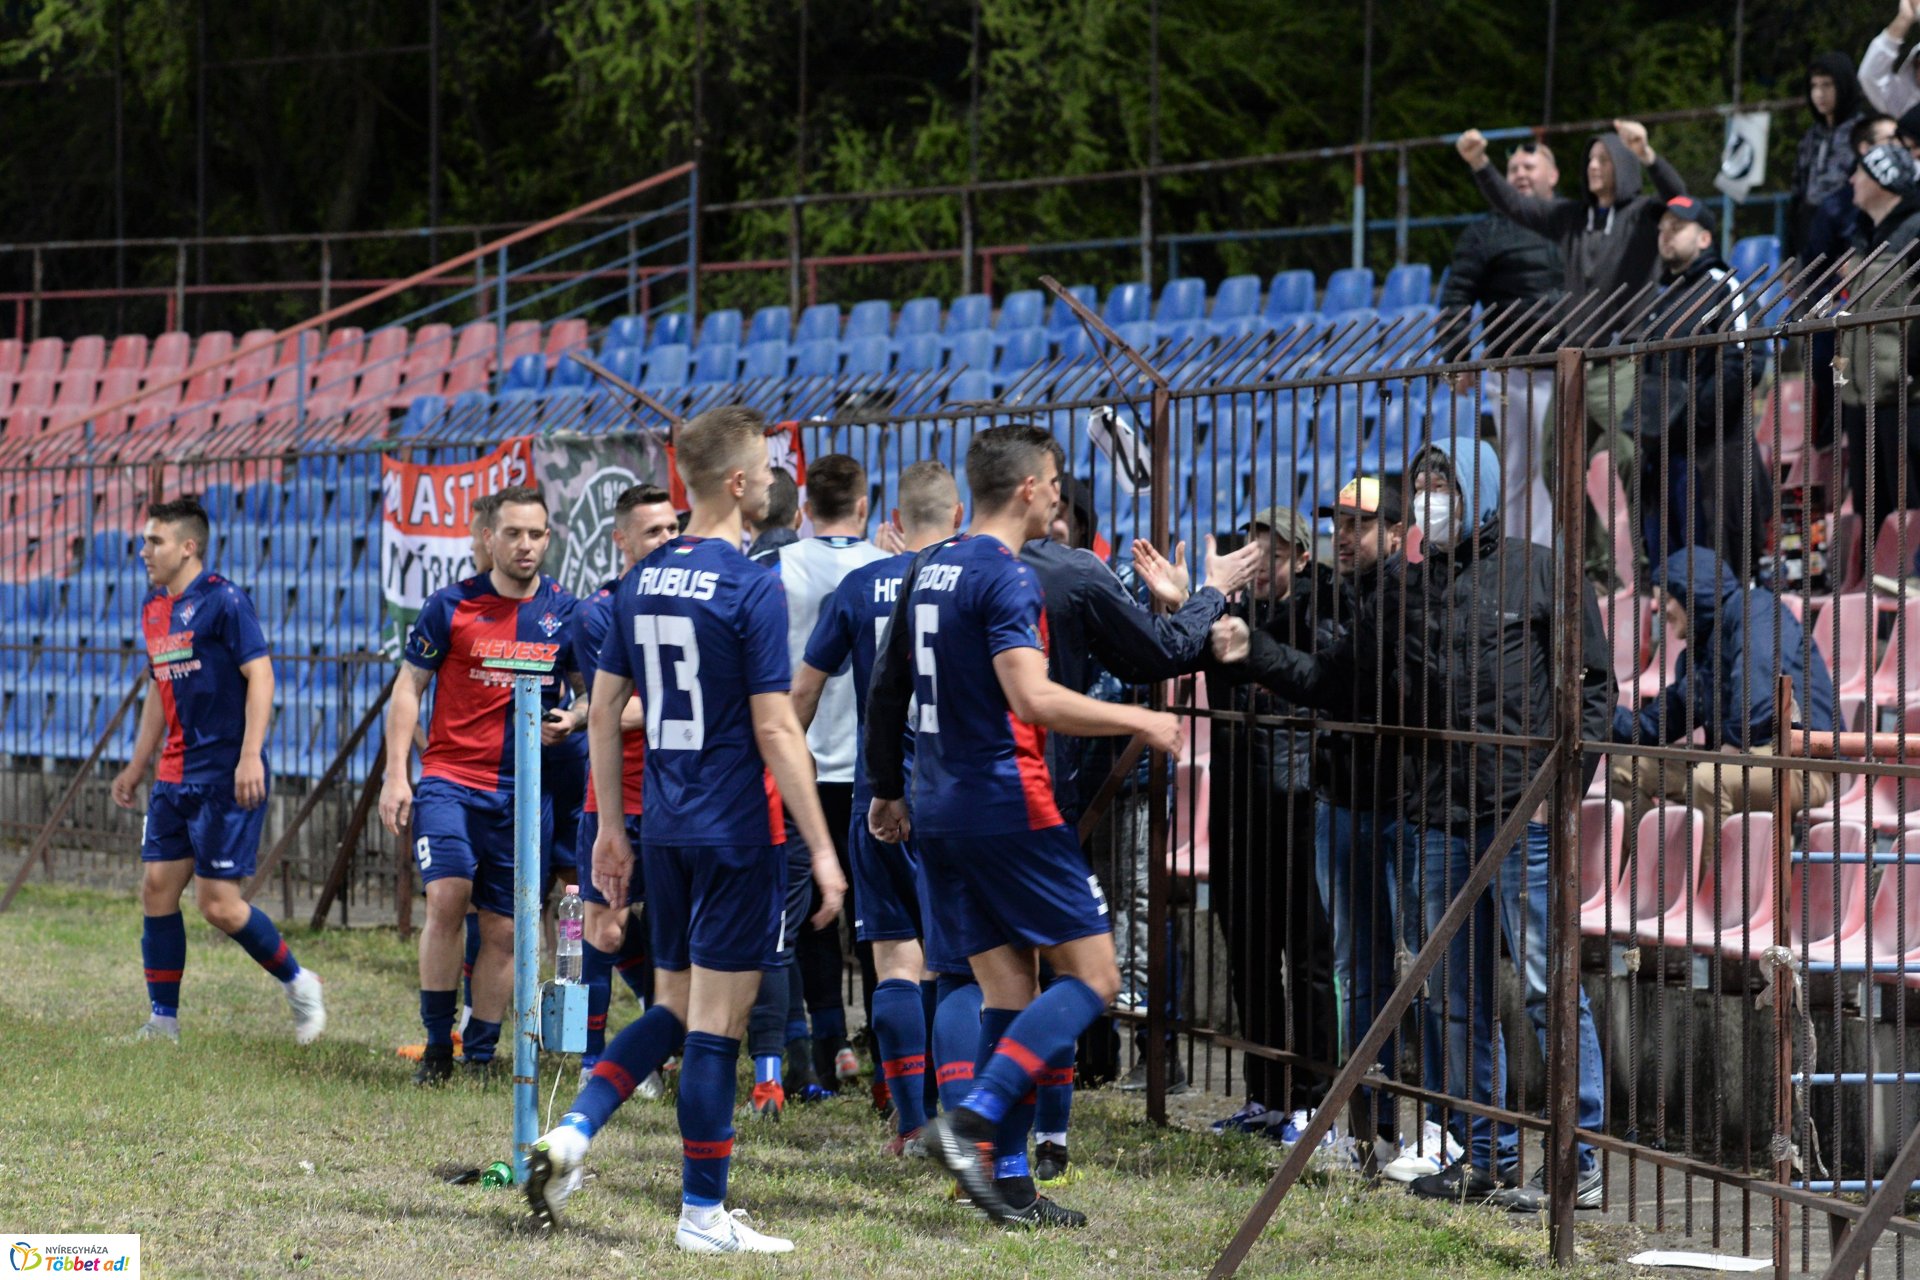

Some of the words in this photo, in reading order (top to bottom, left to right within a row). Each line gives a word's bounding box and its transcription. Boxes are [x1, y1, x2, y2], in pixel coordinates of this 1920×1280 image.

[636, 567, 720, 601] RUBUS
[634, 614, 704, 751] 13
[915, 604, 940, 733] 5
[417, 835, 432, 870] 9
